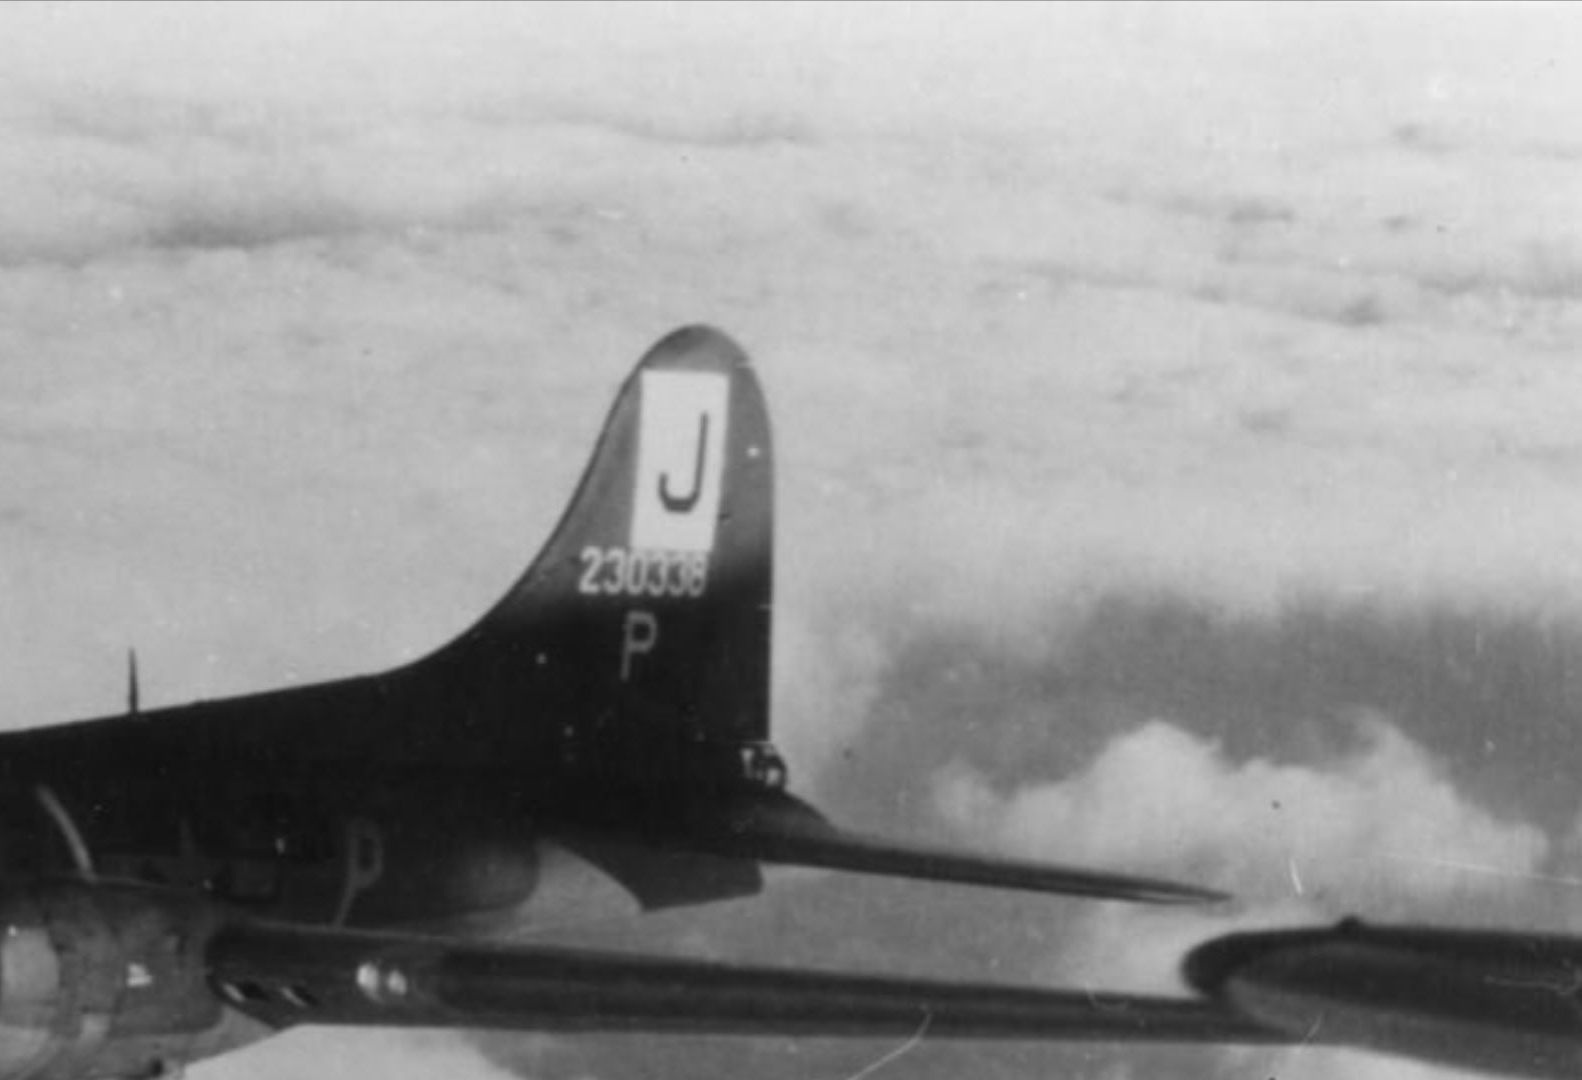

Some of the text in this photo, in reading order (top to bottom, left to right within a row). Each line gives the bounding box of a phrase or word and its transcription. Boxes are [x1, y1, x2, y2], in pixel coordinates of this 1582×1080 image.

[658, 411, 709, 514] J
[578, 547, 707, 597] 230338
[621, 610, 658, 682] P
